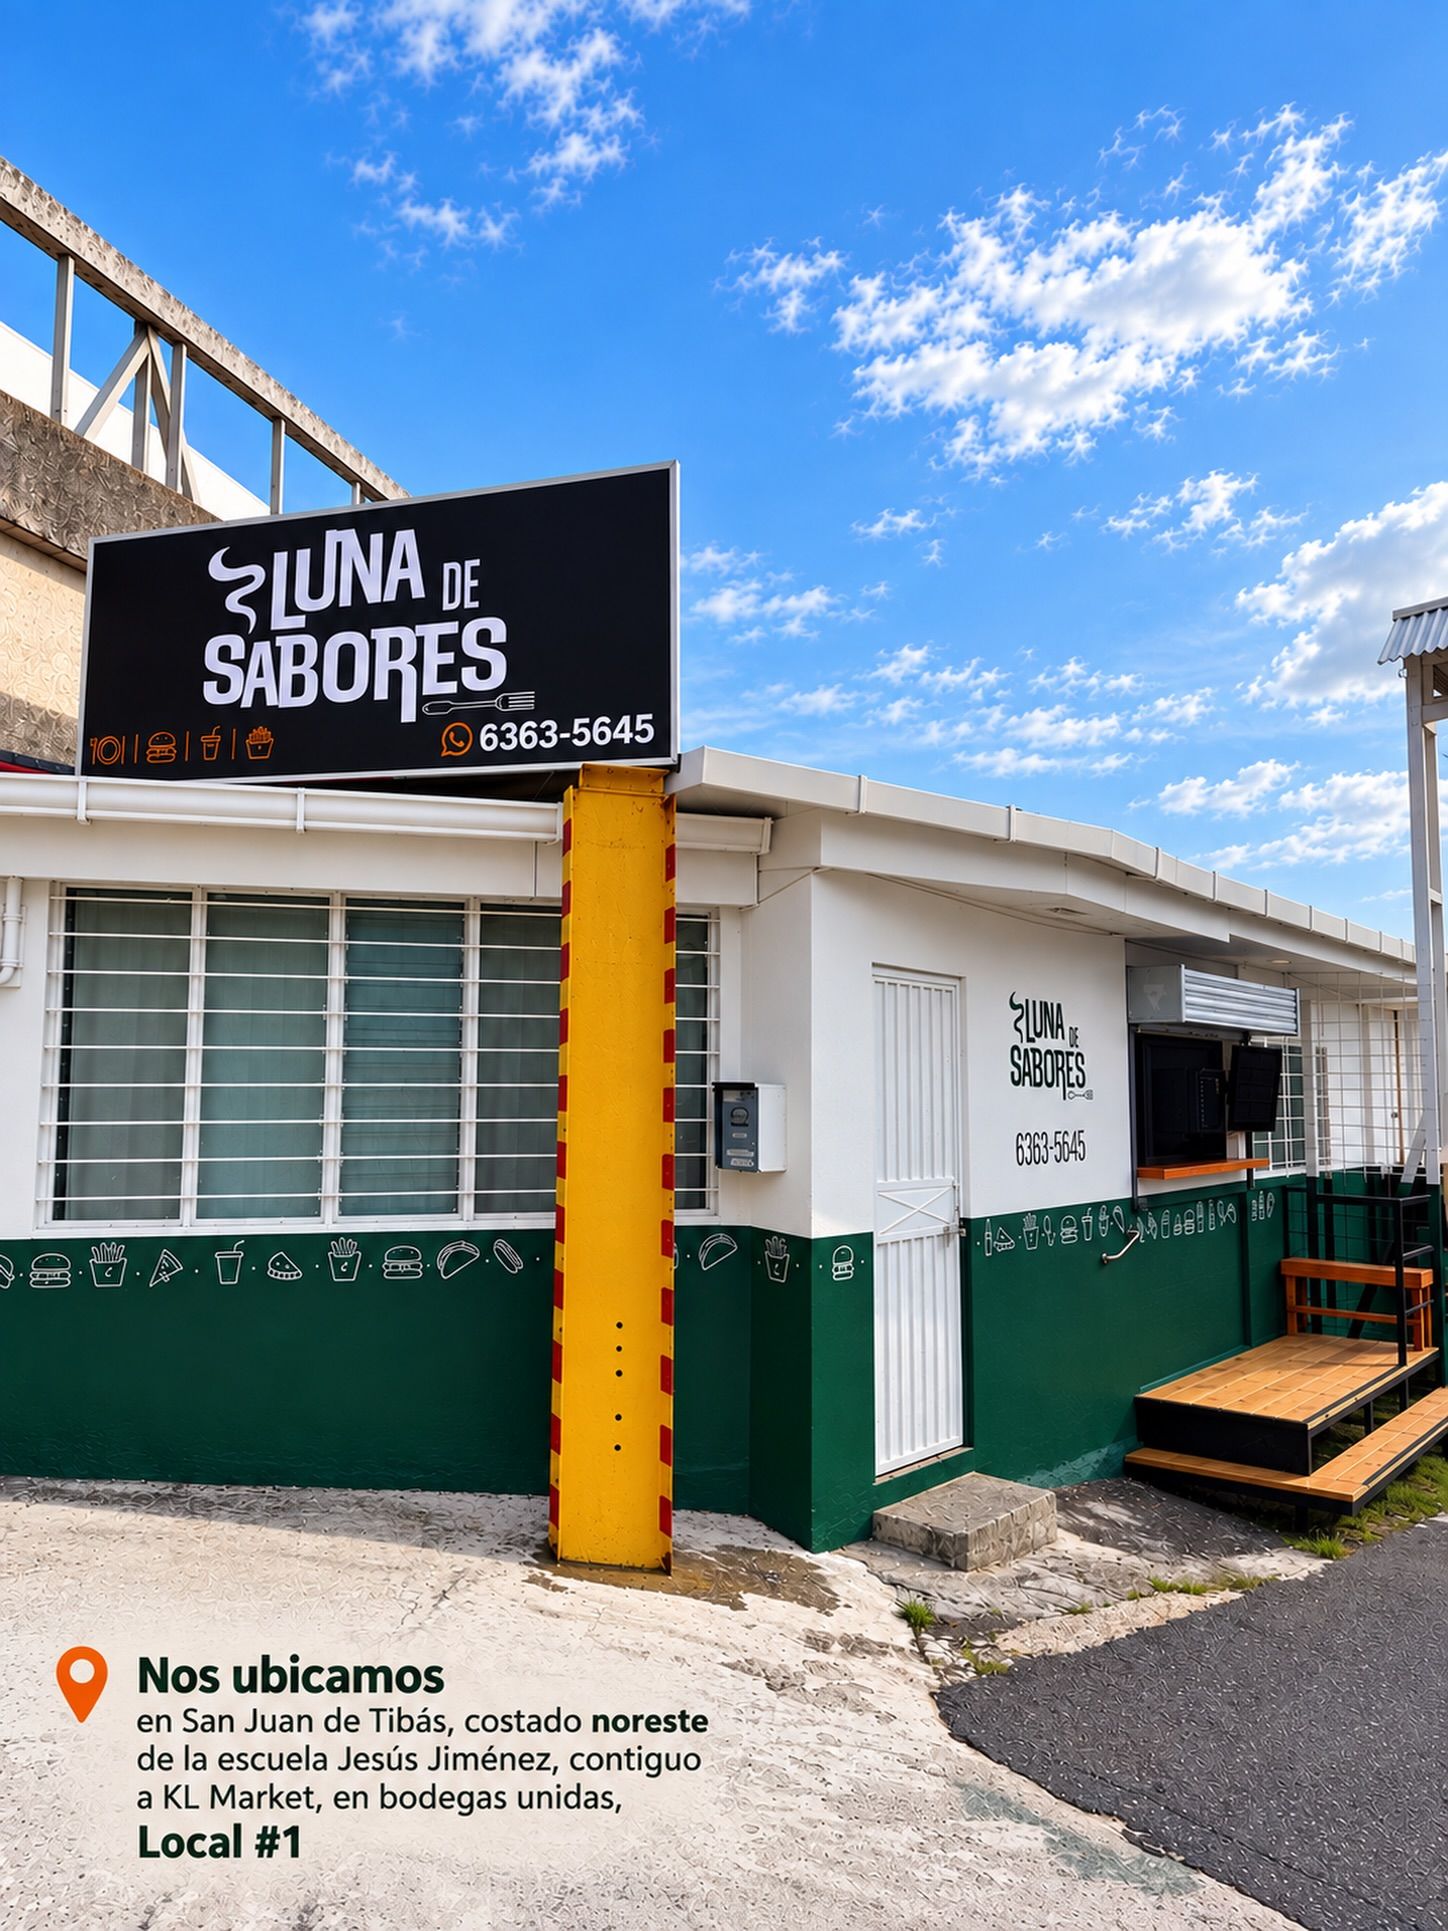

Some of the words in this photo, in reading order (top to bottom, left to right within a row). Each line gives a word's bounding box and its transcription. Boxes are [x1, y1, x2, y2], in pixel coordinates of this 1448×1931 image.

[270, 528, 426, 631] LUNA
[442, 558, 481, 611] DE
[202, 616, 507, 723] SABORES
[479, 713, 655, 752] 6363-5645
[1024, 998, 1066, 1044] LUNA
[1068, 1026, 1079, 1049] DE
[1010, 1044, 1086, 1101] SABORES
[1015, 1129, 1086, 1167] 6363-5645
